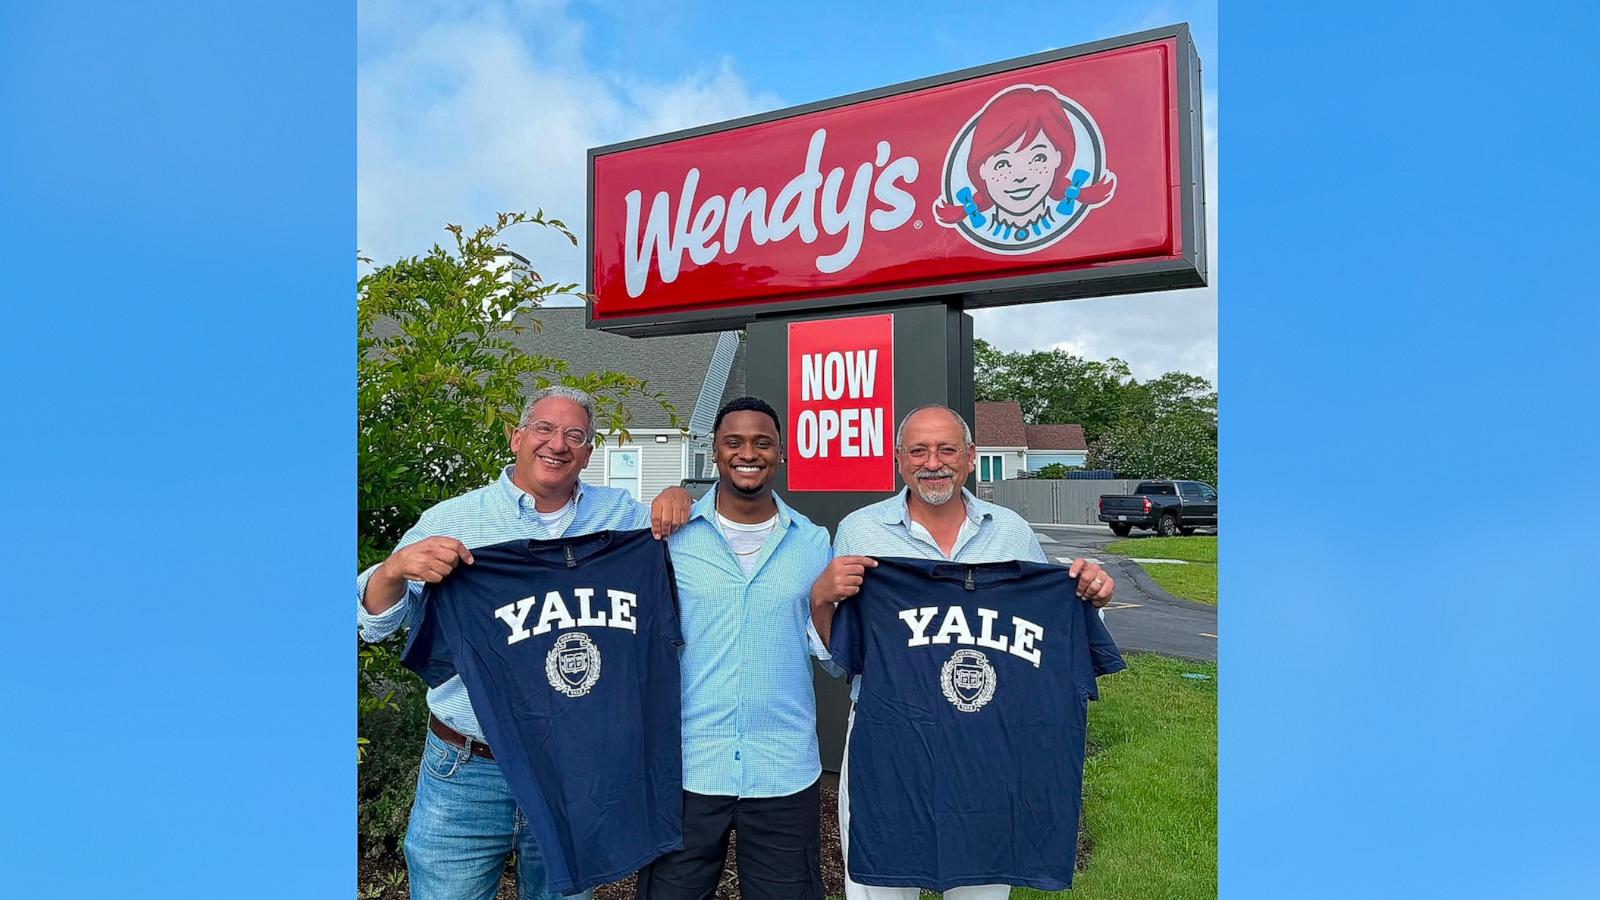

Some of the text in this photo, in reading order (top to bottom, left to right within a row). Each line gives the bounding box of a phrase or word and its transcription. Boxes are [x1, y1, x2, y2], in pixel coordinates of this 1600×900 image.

[625, 129, 919, 298] Wendy's
[802, 349, 878, 401] NOW
[796, 408, 884, 459] OPEN
[494, 588, 637, 645] YALE
[898, 605, 1044, 667] YALE
